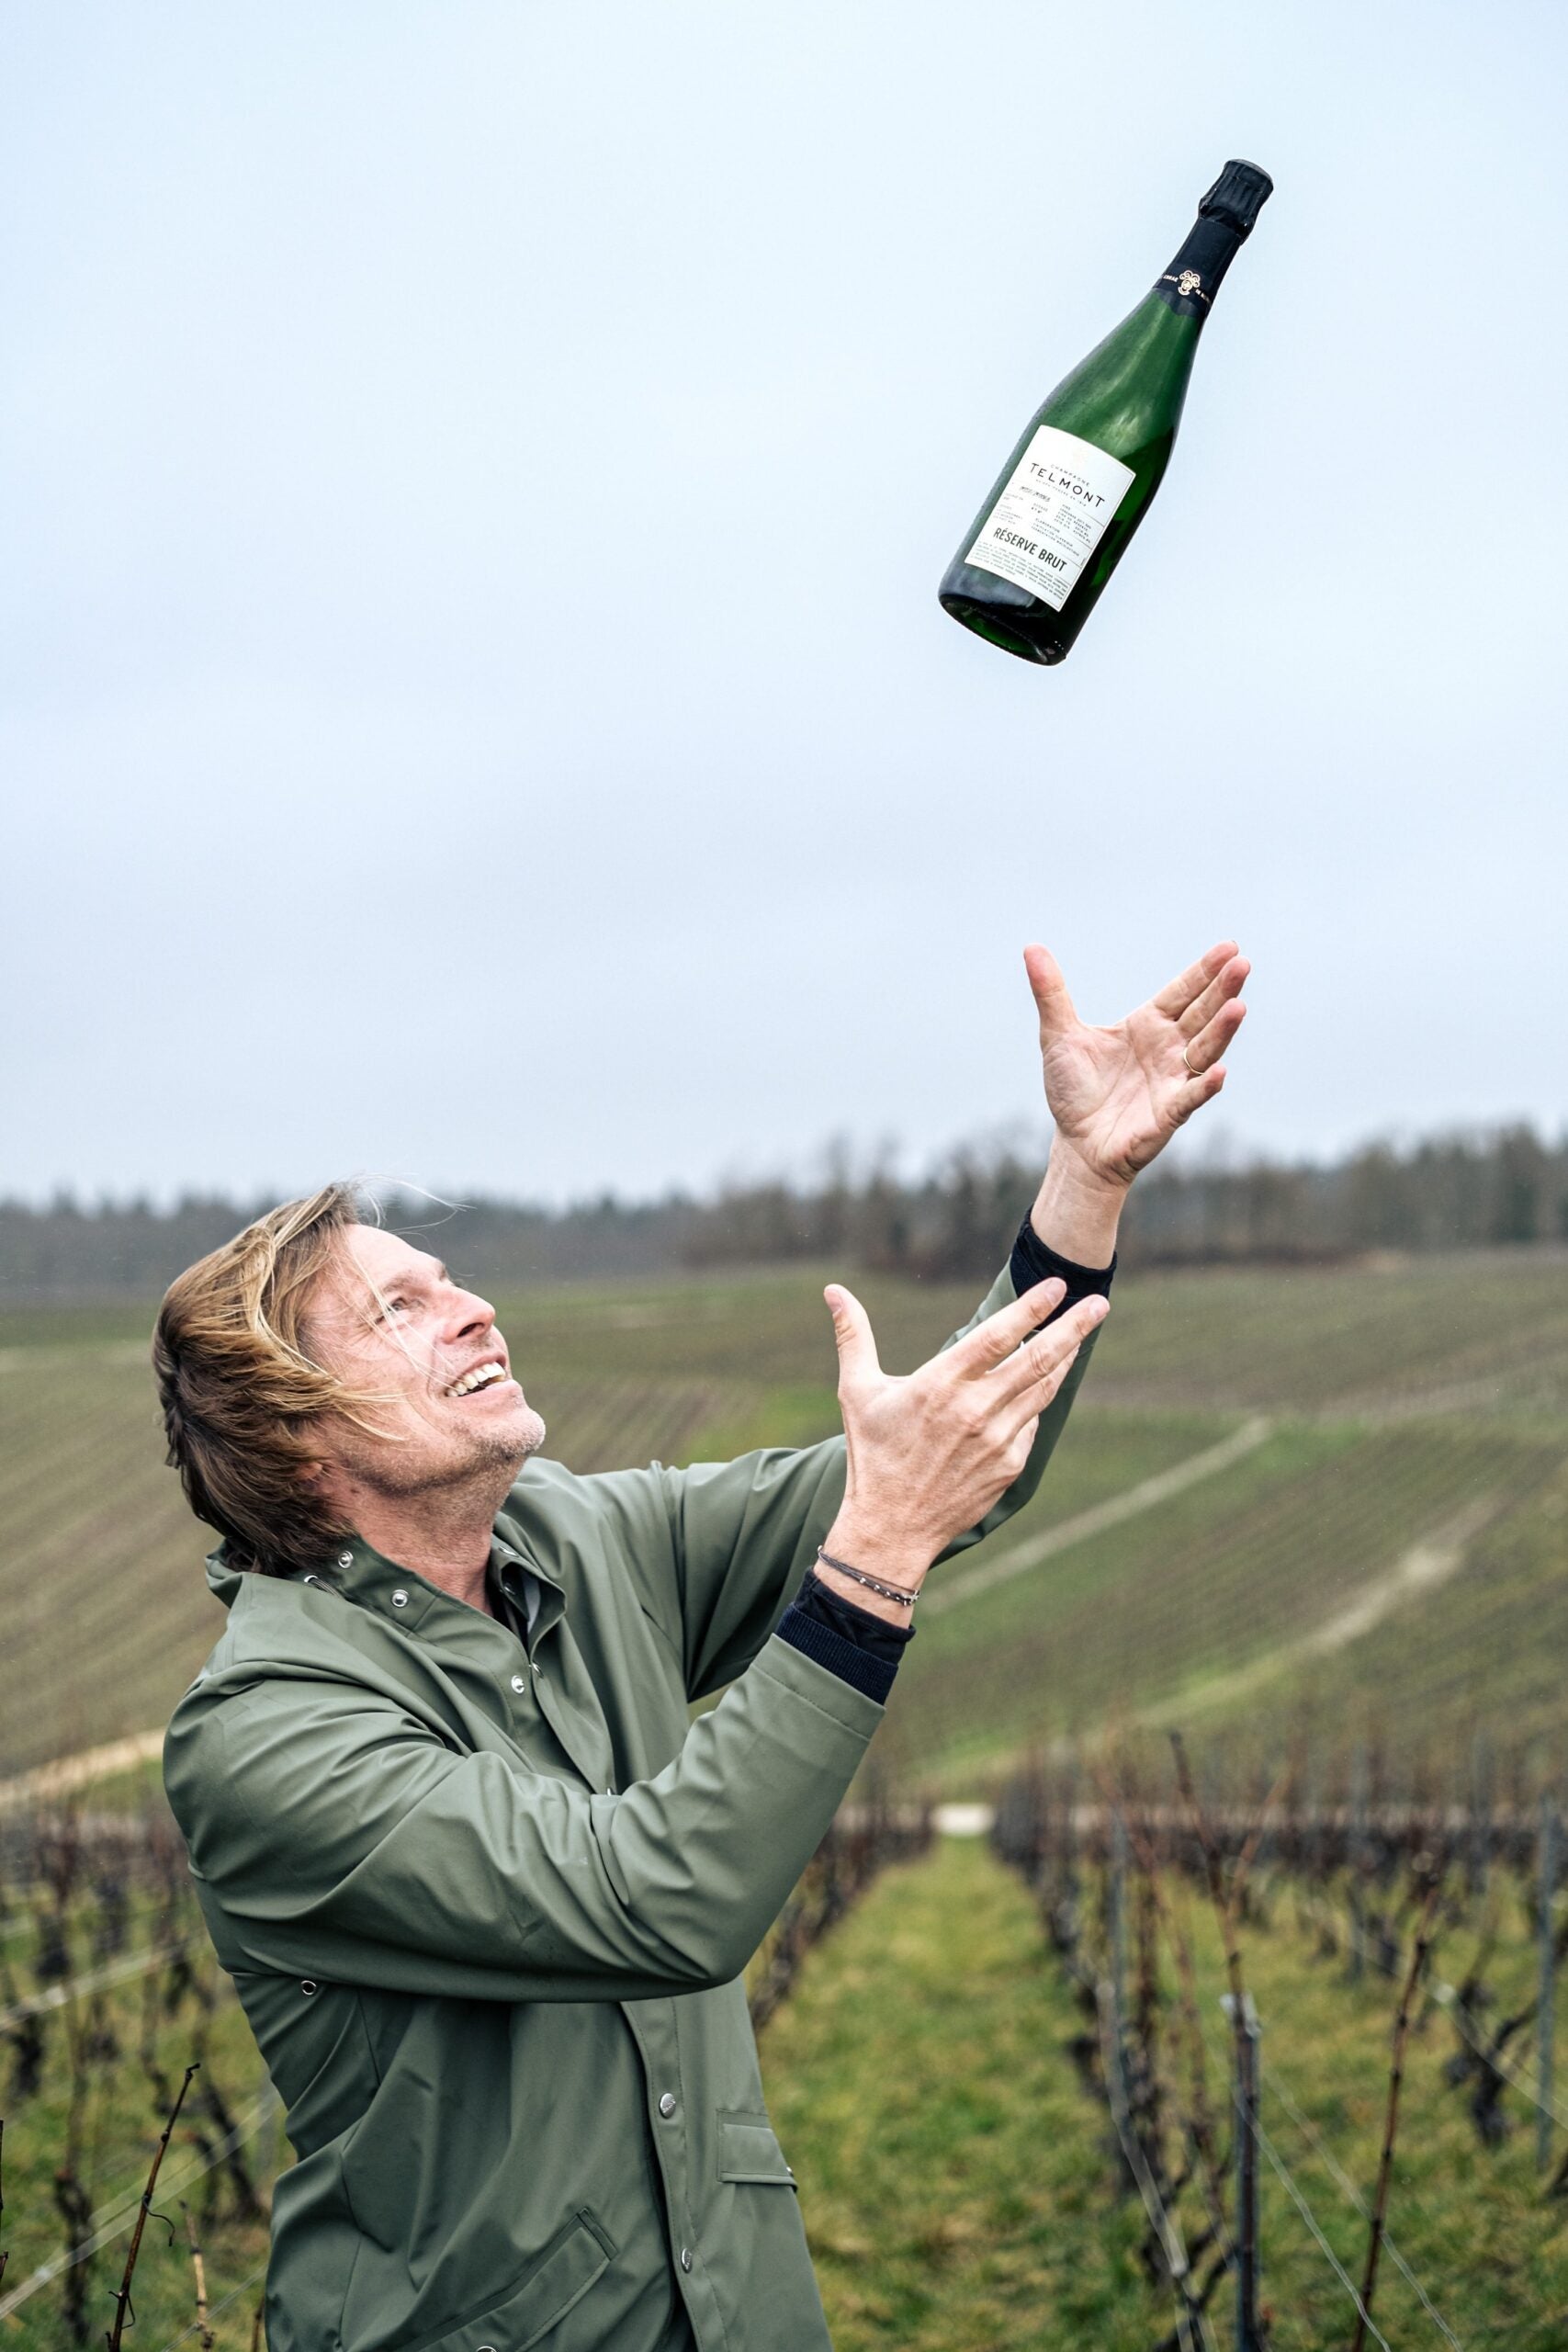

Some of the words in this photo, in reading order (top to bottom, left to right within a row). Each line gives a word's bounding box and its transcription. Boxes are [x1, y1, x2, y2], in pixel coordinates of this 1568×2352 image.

[1029, 462, 1105, 508] TELMONT
[1050, 464, 1090, 486] CHAMPAGNE
[993, 526, 1038, 555] RÉSERVE
[1038, 548, 1067, 572] BRUT
